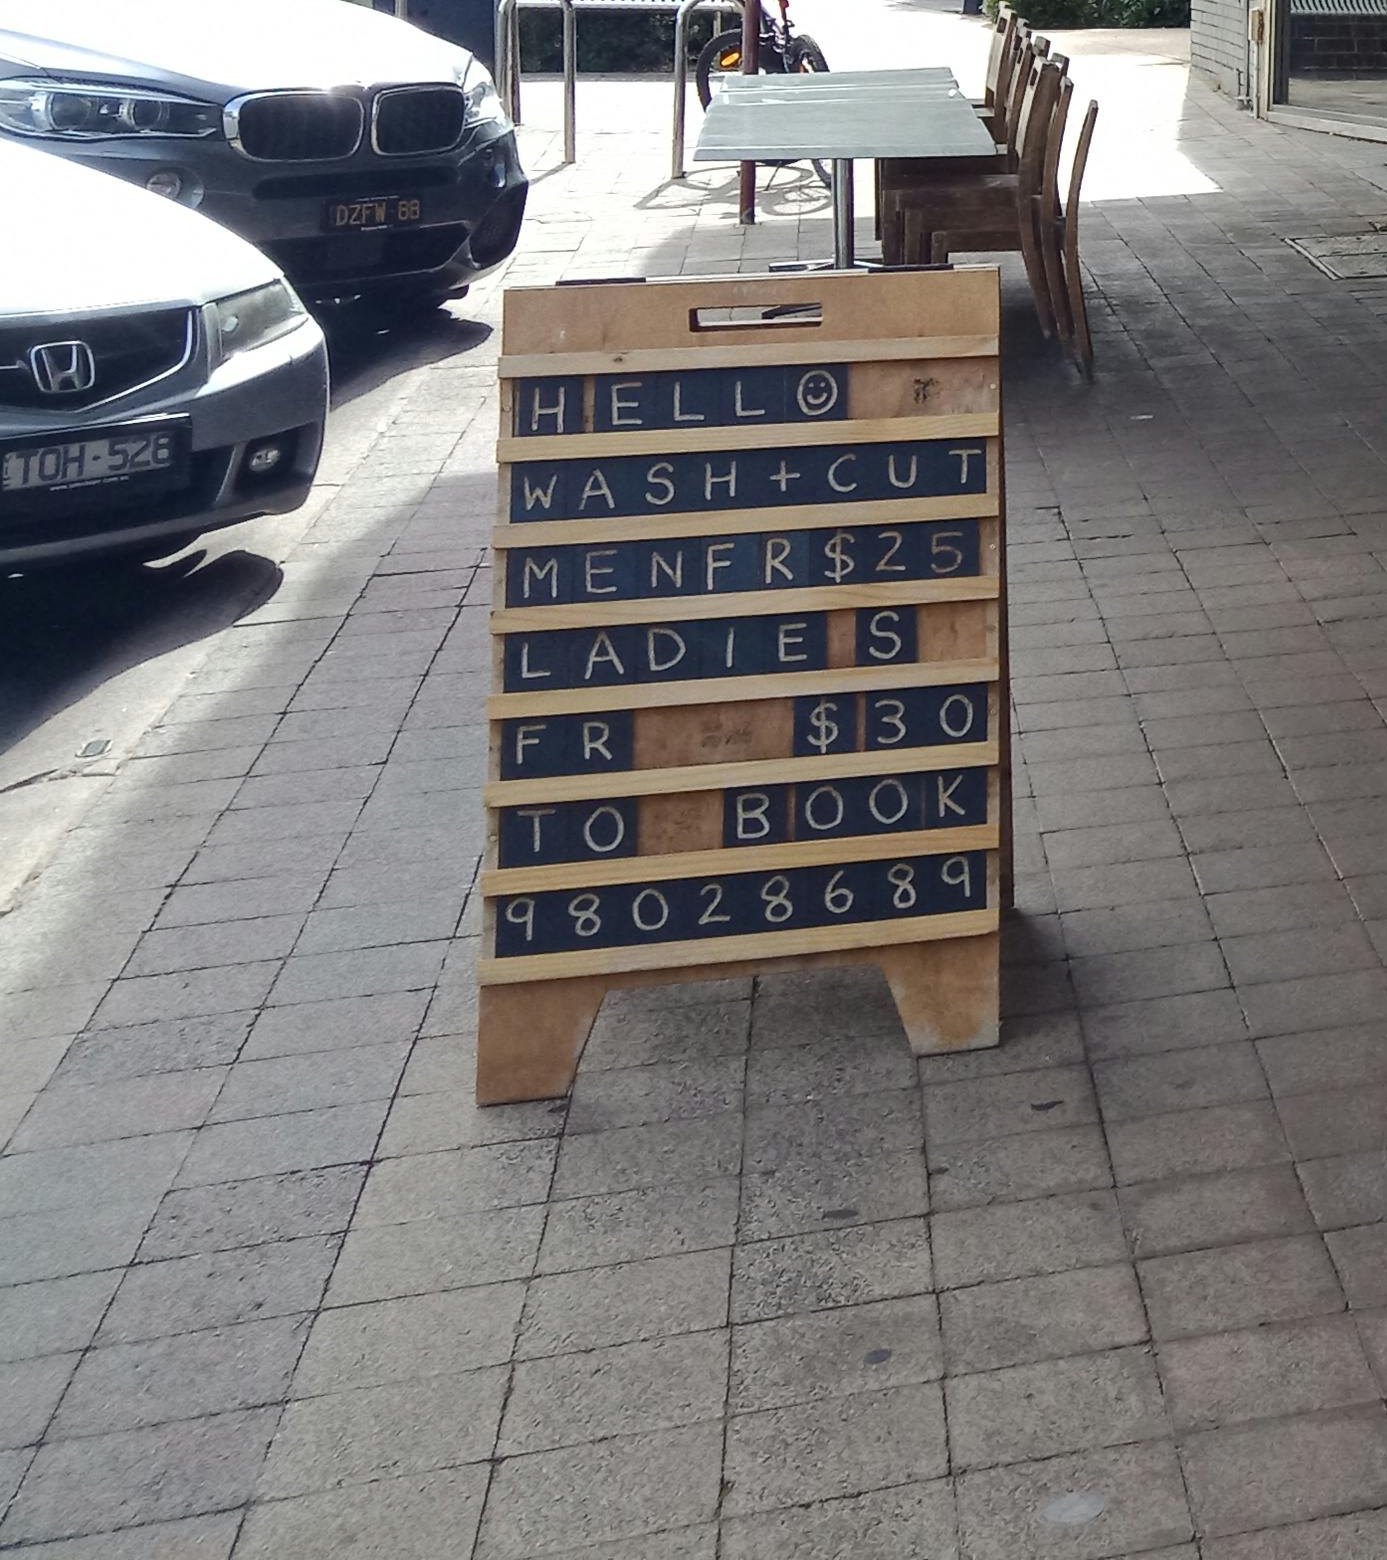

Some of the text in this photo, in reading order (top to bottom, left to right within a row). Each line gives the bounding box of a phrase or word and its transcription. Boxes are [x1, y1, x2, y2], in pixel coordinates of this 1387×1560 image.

[520, 611, 903, 680] LADIES
[516, 693, 975, 767] FR $30
[516, 775, 967, 854] TO BOOK
[505, 855, 973, 944] 98028689
